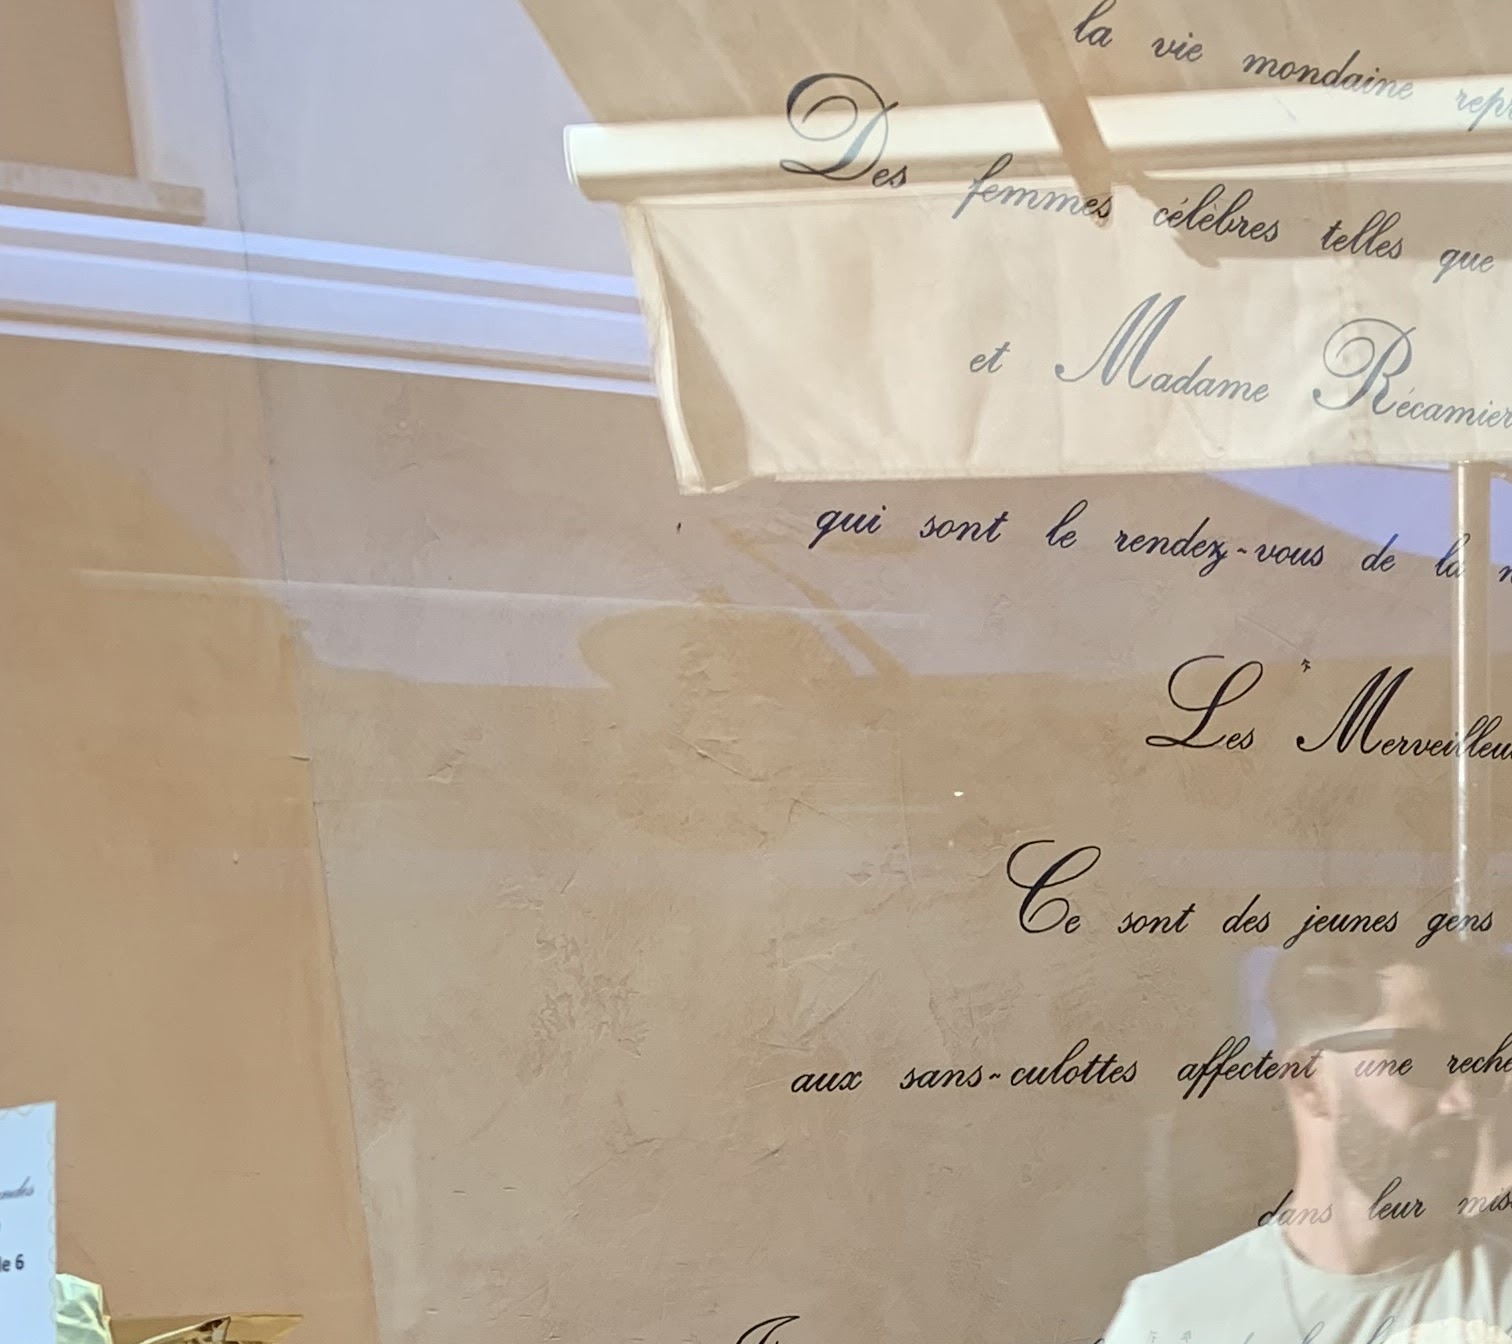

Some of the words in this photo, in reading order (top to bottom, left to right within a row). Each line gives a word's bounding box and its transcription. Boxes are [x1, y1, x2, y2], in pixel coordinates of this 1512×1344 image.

[1074, 0, 1116, 48] la
[1151, 32, 1204, 63] vie
[1242, 49, 1414, 101] mondaine
[779, 72, 908, 188] Des
[952, 152, 1114, 220] femmes
[1152, 183, 1280, 243] célèbres
[1320, 209, 1404, 261] telles
[1432, 244, 1495, 284] que
[969, 341, 1012, 374] et
[1054, 292, 1270, 404] Madame
[808, 504, 888, 549] qui
[918, 510, 1010, 543] sont
[1044, 500, 1089, 549] le
[1115, 517, 1325, 578] rendez-vous
[1361, 533, 1398, 573] de
[1435, 532, 1471, 578] la
[1145, 654, 1264, 751] Les
[1006, 839, 1101, 934] Ce
[1117, 902, 1197, 935] sont
[1222, 894, 1272, 934] des
[1283, 905, 1400, 950] jeunes
[1415, 910, 1495, 949] gens
[790, 1067, 865, 1093] aux
[899, 1037, 1140, 1091] sans-culottes
[1176, 1035, 1325, 1100] affectent
[1353, 1056, 1414, 1078] une
[1257, 1189, 1333, 1228] dans
[1368, 1175, 1428, 1221] leur
